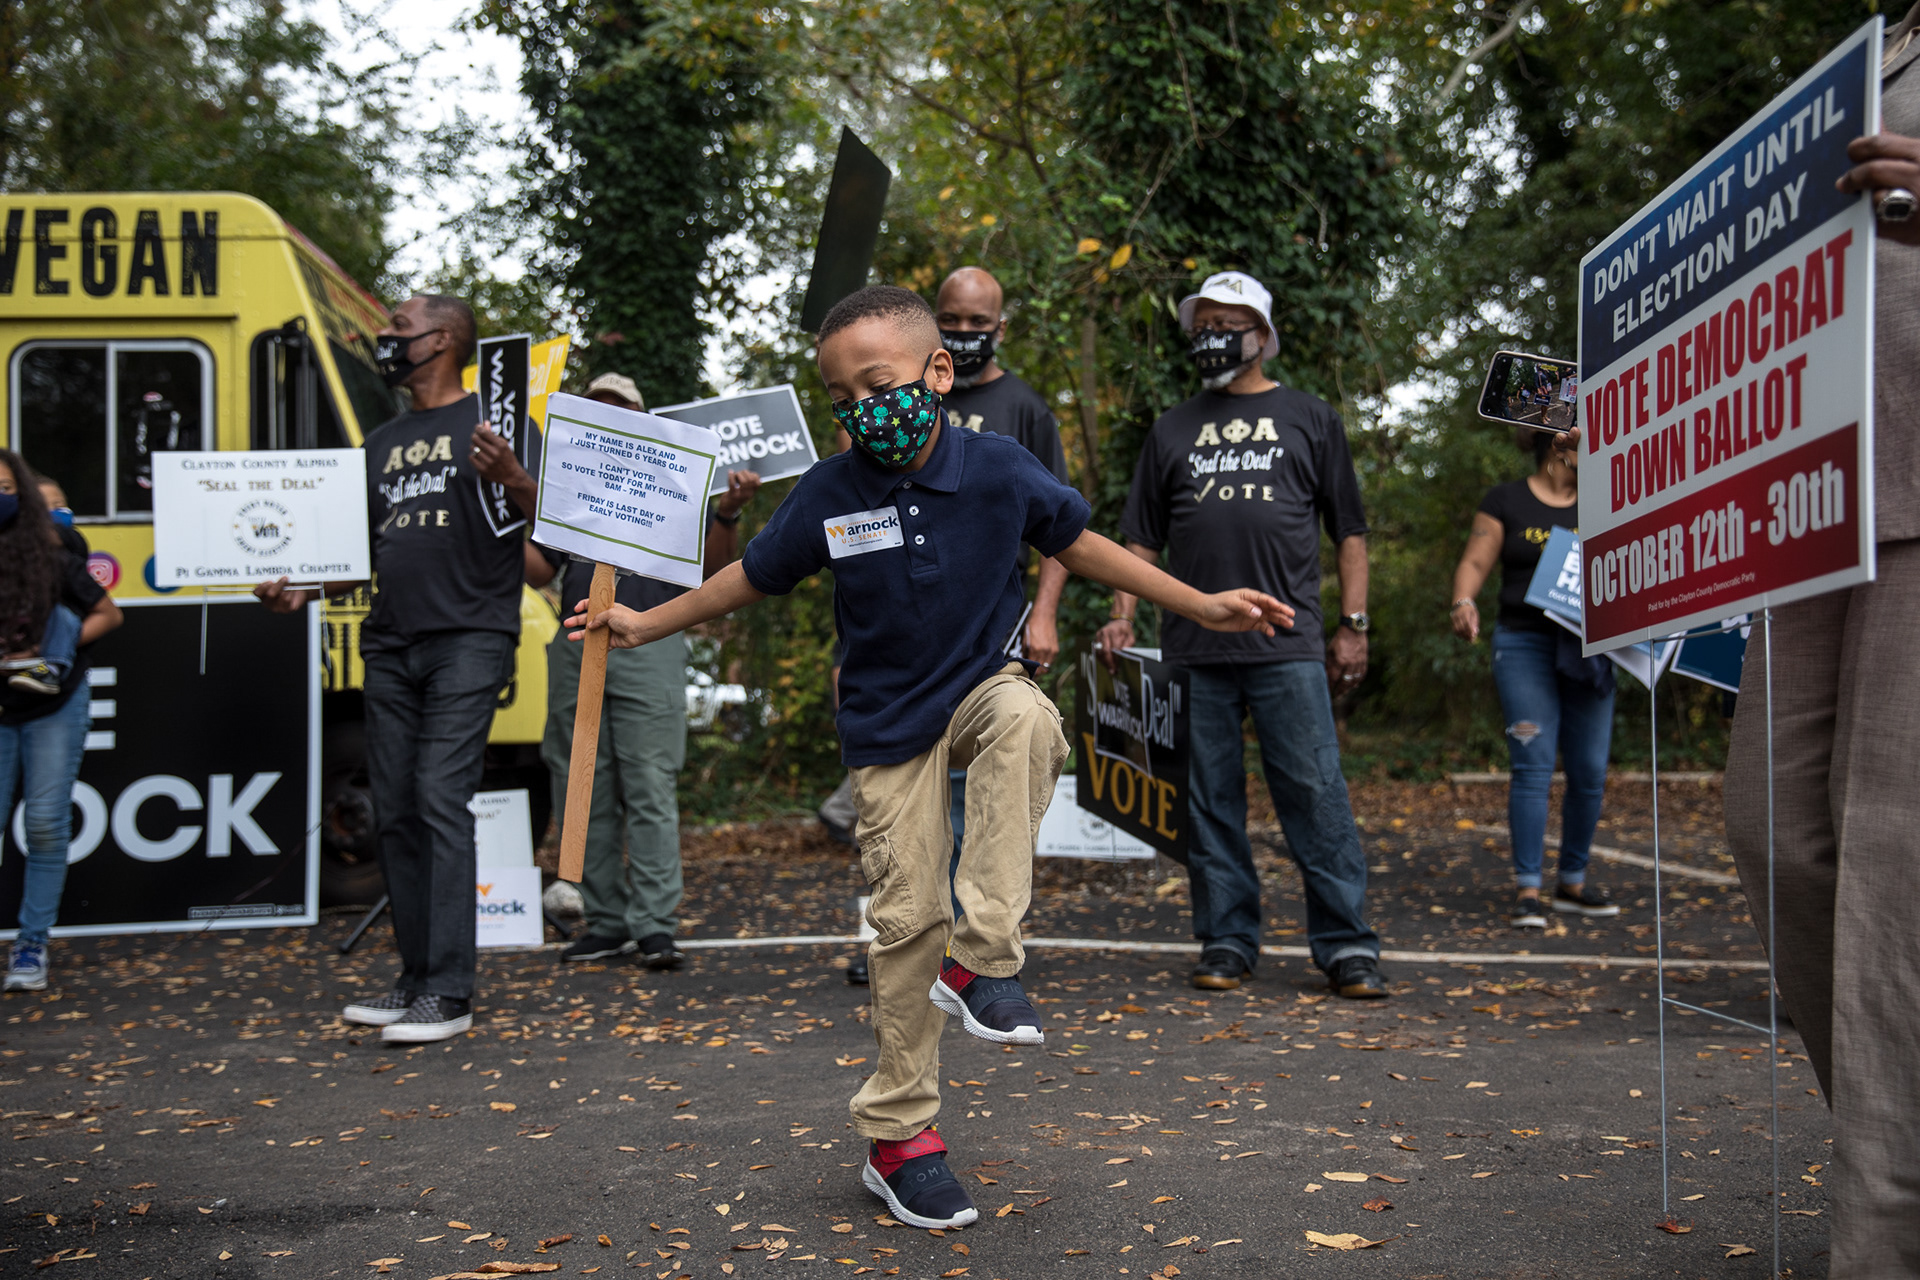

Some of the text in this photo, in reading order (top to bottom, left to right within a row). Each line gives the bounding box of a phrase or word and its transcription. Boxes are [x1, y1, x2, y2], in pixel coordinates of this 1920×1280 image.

[1593, 86, 1845, 305] DON'T WAIT UNTIL
[0, 207, 219, 297] VEGAN
[1612, 171, 1808, 343] ELECTION DAY
[1585, 228, 1854, 456] VOTE DEMOCRAT
[585, 431, 676, 461] MY NAME IS ALEX AND
[717, 430, 805, 468] RNOCK
[1610, 352, 1808, 514] DOWN BALLOT
[575, 439, 597, 450] JUST
[598, 444, 632, 458] TURNED
[642, 454, 667, 468] YEARS
[668, 462, 688, 474] OLD!
[605, 464, 631, 476] CAN'T
[632, 471, 656, 483] VOTE!
[561, 461, 688, 502] SO VOTE TODAY FOR MY FUTURE
[604, 481, 622, 492] 8AM
[629, 487, 646, 499] 7PM
[577, 492, 666, 523] FRIDAY IS LAST DAY OF
[588, 504, 653, 528] EARLY VOTING!!!
[826, 515, 899, 539] Warnock
[858, 530, 888, 541] SENATE
[1590, 523, 1685, 607] OCTOBER
[1688, 500, 1744, 573] 12th
[1767, 460, 1845, 546] 30th
[1648, 602, 1658, 612] Paid
[1664, 599, 1670, 608] by
[1670, 596, 1678, 605] the
[1678, 591, 1696, 603] Clayton
[1695, 586, 1713, 597] County
[1713, 577, 1741, 592] Democratic
[1741, 572, 1755, 583] Party
[1082, 732, 1178, 841] VOTE
